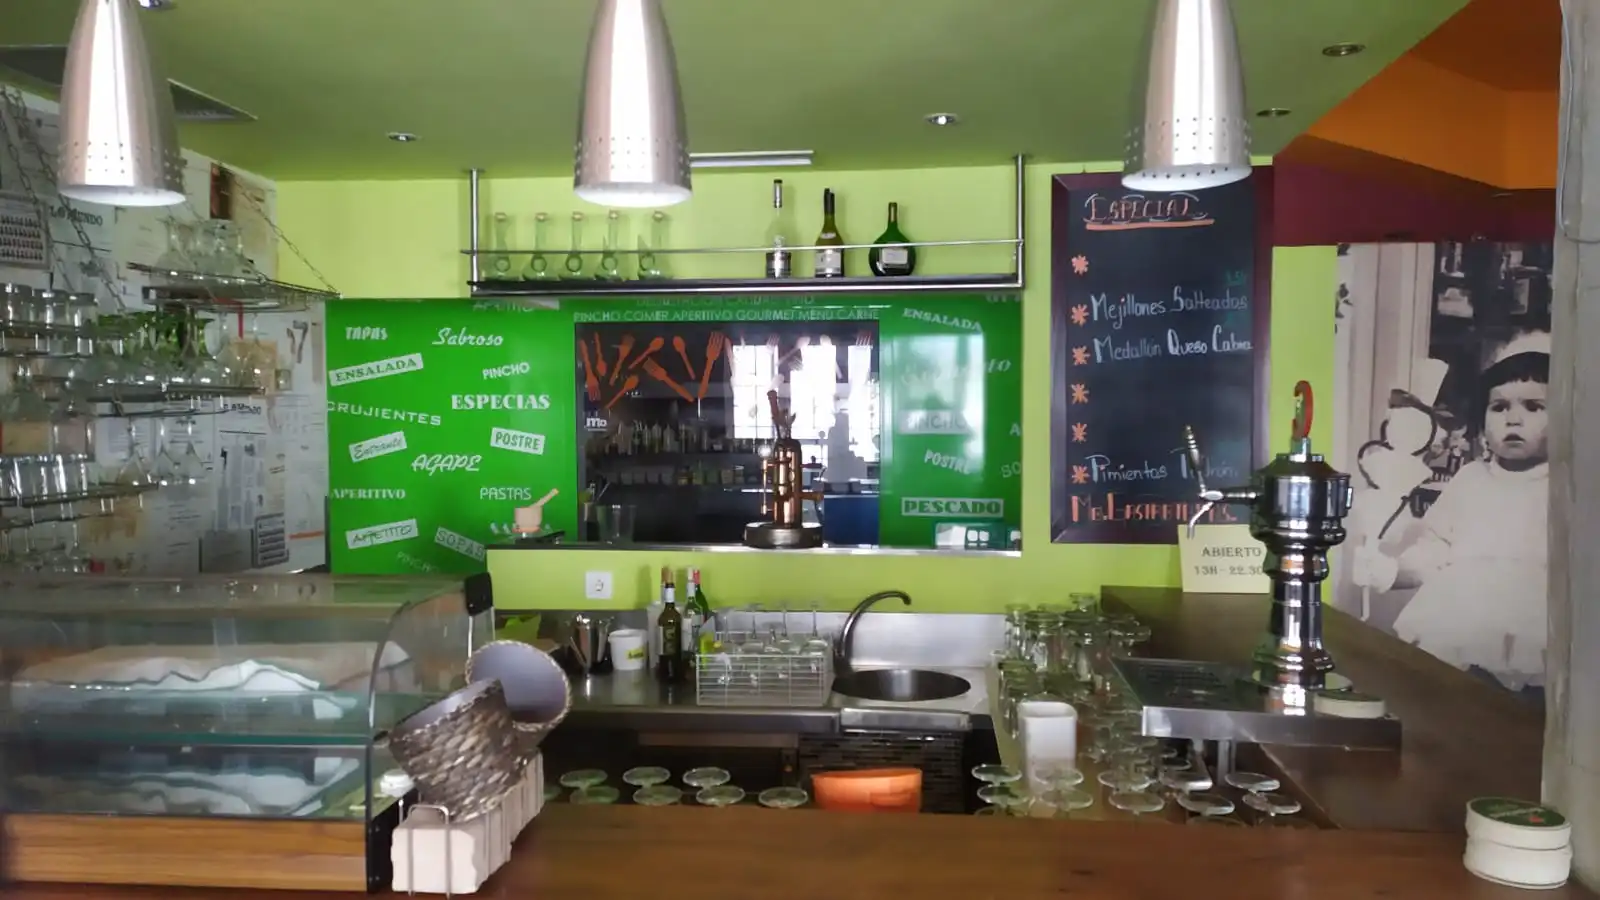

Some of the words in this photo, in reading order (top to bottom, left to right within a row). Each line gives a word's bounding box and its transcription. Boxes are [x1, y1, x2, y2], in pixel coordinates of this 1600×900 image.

[573, 310, 621, 322] PINCHO
[623, 309, 669, 321] COMER
[672, 309, 733, 321] APERITIVO
[1090, 293, 1166, 330] Mejillones
[1170, 285, 1248, 313] Salteados
[902, 308, 983, 332] ENSALADA
[345, 326, 388, 341] TAPAS
[432, 327, 504, 346] Sabroso
[1167, 328, 1208, 356] Queso
[335, 357, 417, 383] ENSALADA
[482, 362, 530, 380] PINCHO
[451, 394, 551, 410] ESPECIAS
[327, 400, 442, 426] CRUJIENTES
[495, 430, 541, 451] POSTRE
[411, 454, 482, 476] AGAPE
[332, 488, 406, 499] APERITIVO
[479, 487, 532, 500] PASTAS
[904, 500, 1000, 514] PESCADO
[436, 530, 485, 557] SOPAS
[1201, 546, 1262, 558] ABIERTO
[1194, 565, 1218, 576] 13H
